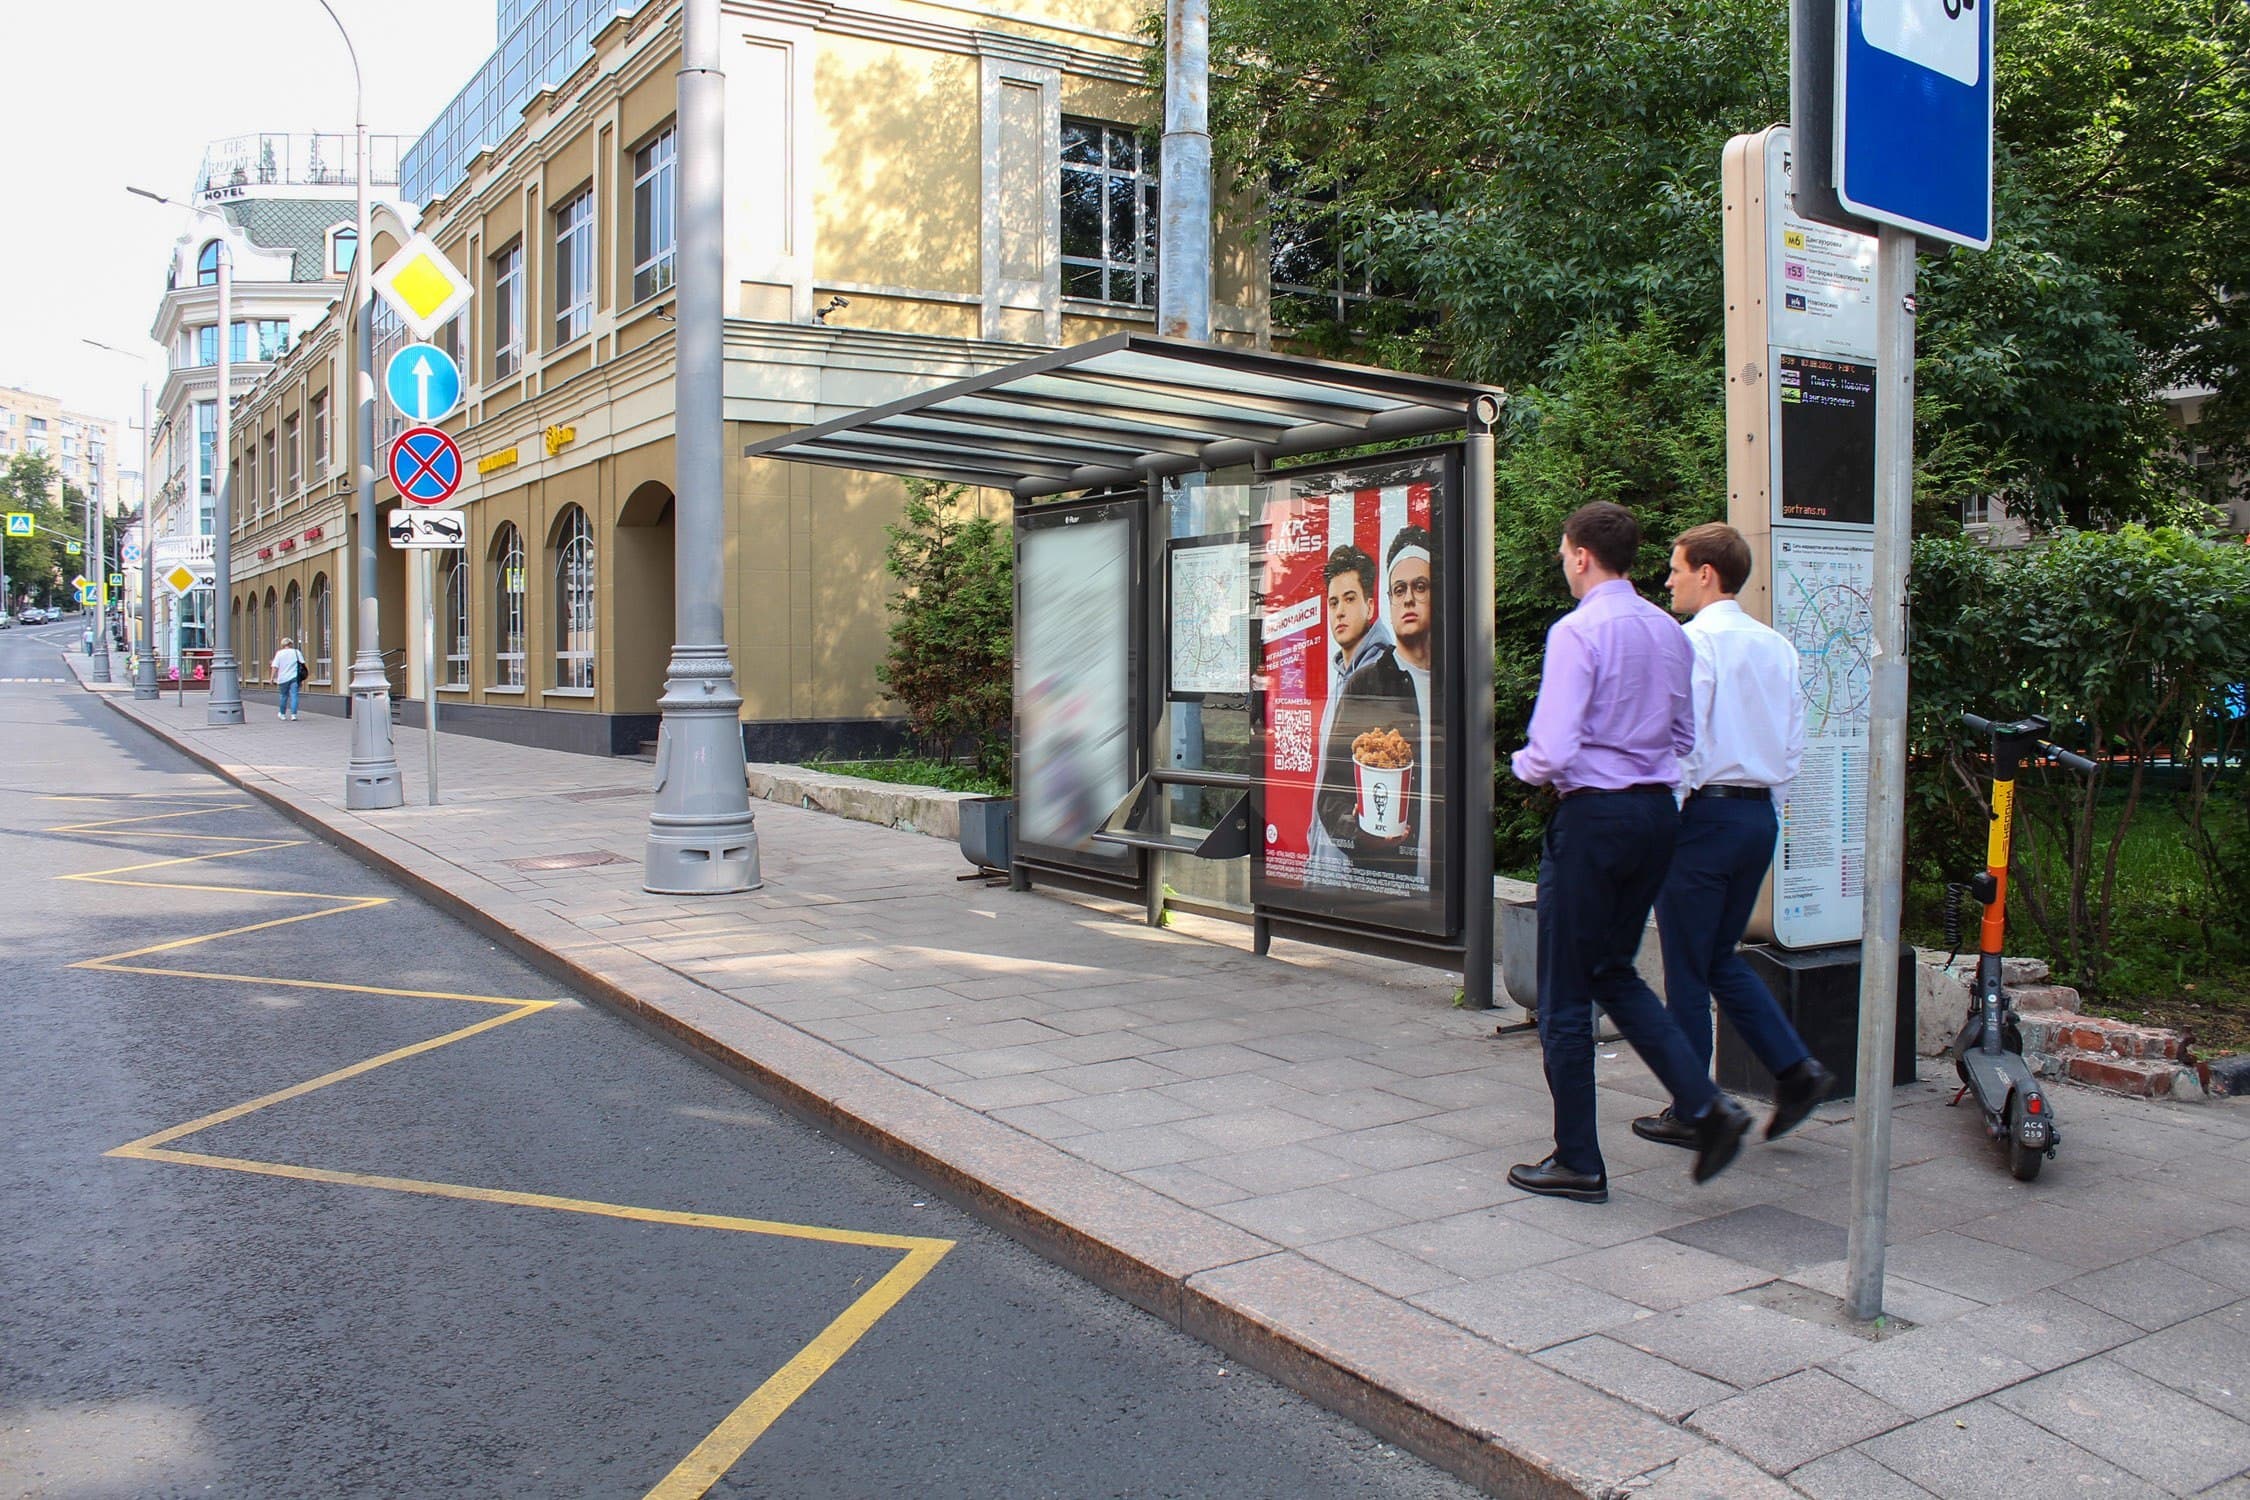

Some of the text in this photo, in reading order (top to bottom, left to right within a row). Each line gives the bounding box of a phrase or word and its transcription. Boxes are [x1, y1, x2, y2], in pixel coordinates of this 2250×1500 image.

[1280, 518, 1310, 537] KFC
[1266, 534, 1322, 554] GAMES
[1374, 823, 1388, 832] KFC
